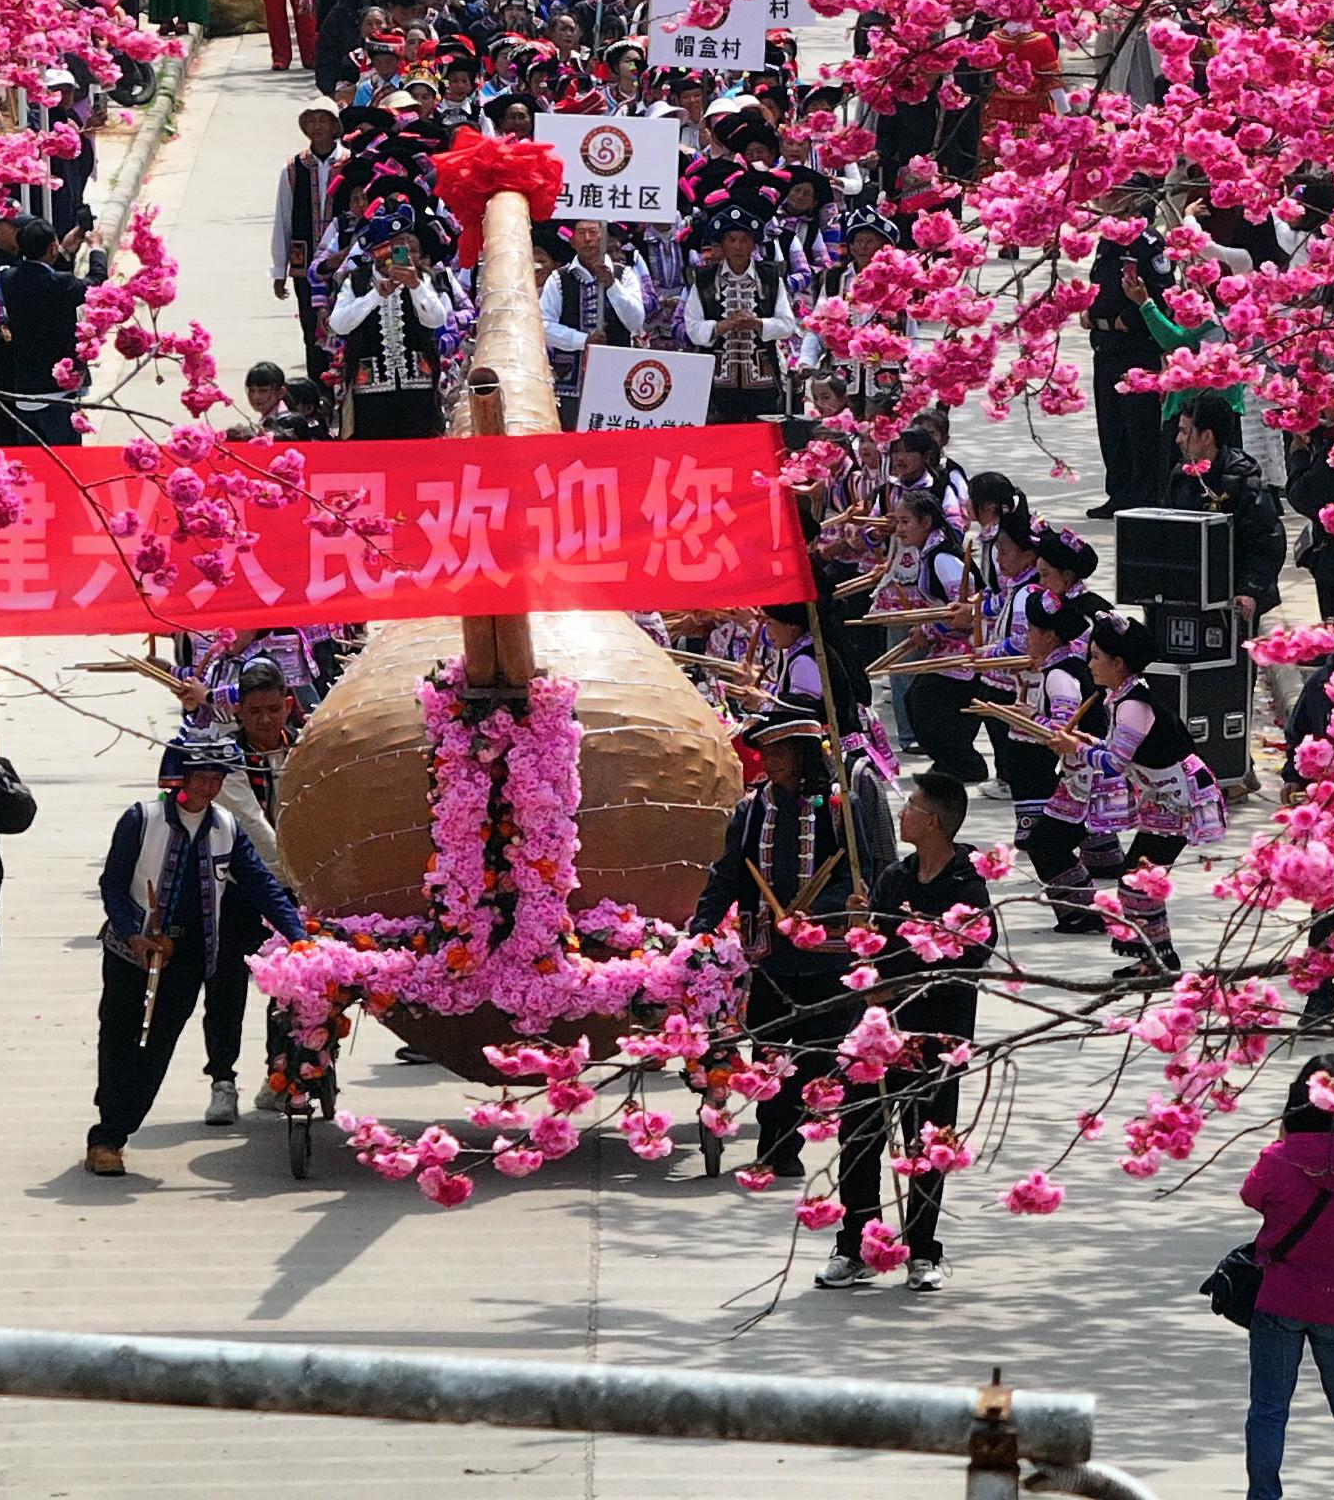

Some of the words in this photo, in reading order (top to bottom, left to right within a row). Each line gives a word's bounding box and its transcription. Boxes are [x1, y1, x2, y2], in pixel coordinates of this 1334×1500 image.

[674, 35, 742, 60] 帽盒村
[556, 184, 662, 210] 马鹿社区
